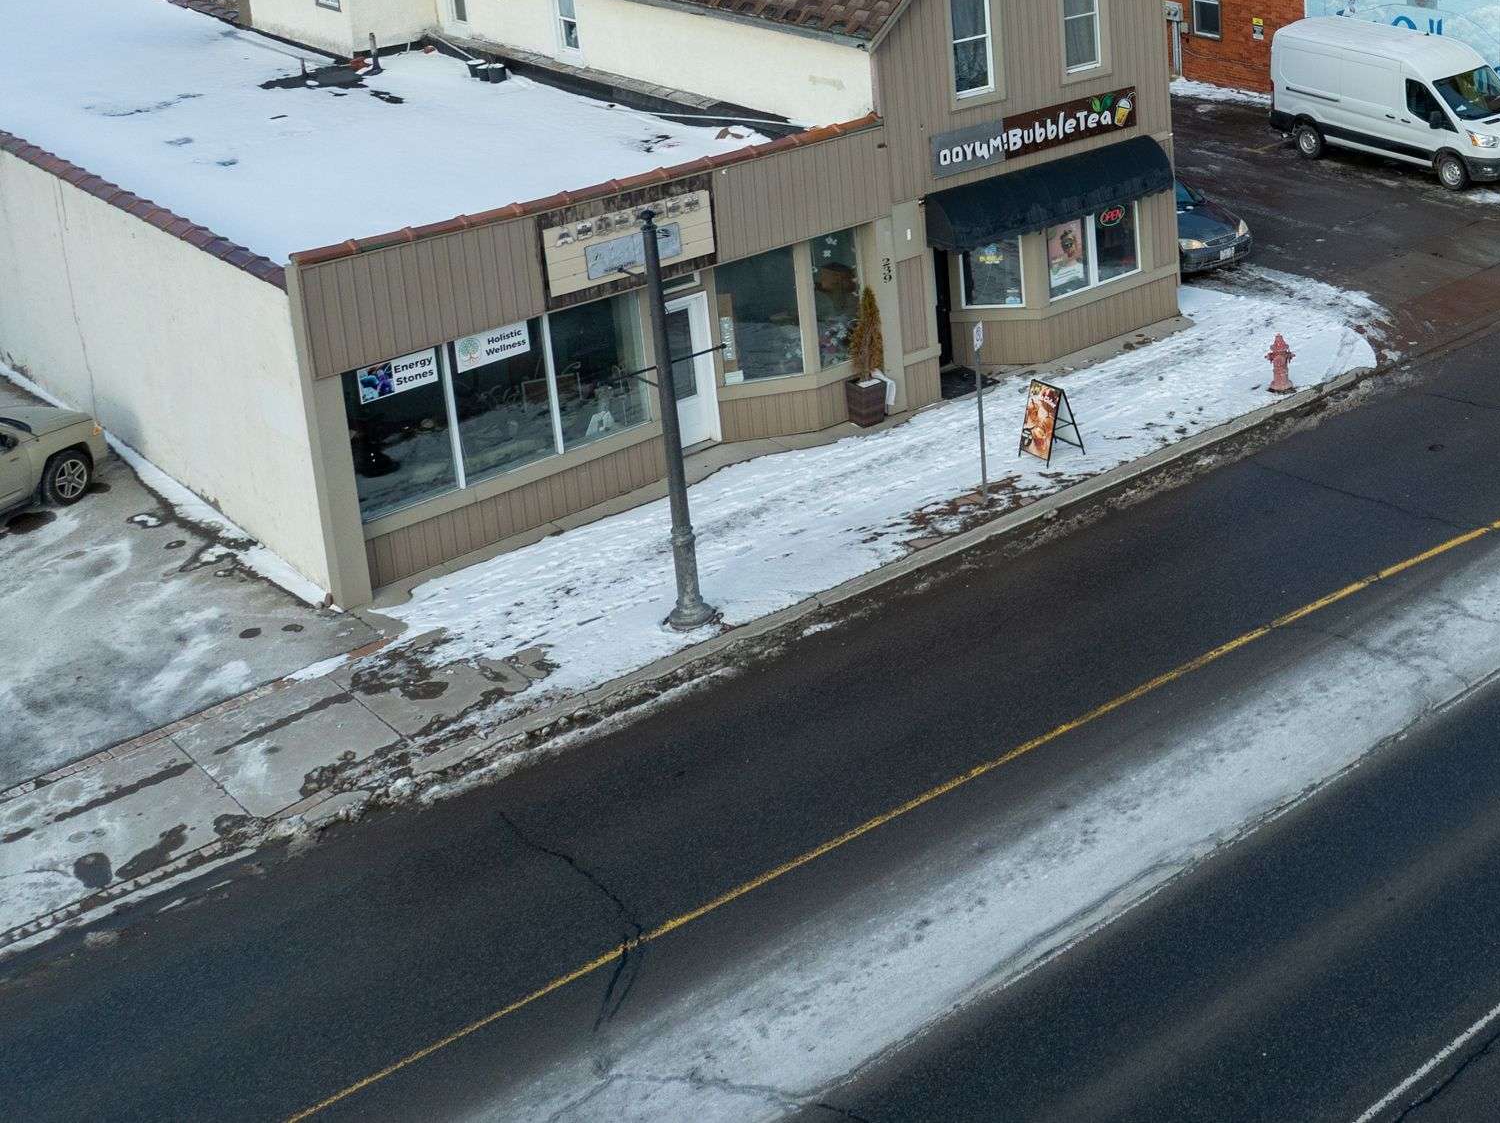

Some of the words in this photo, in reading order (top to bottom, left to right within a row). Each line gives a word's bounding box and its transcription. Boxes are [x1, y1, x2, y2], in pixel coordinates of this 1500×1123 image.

[487, 329, 522, 345] Holistic
[485, 338, 527, 357] Wellness
[393, 355, 433, 375] Energy
[396, 368, 434, 386] Stones
